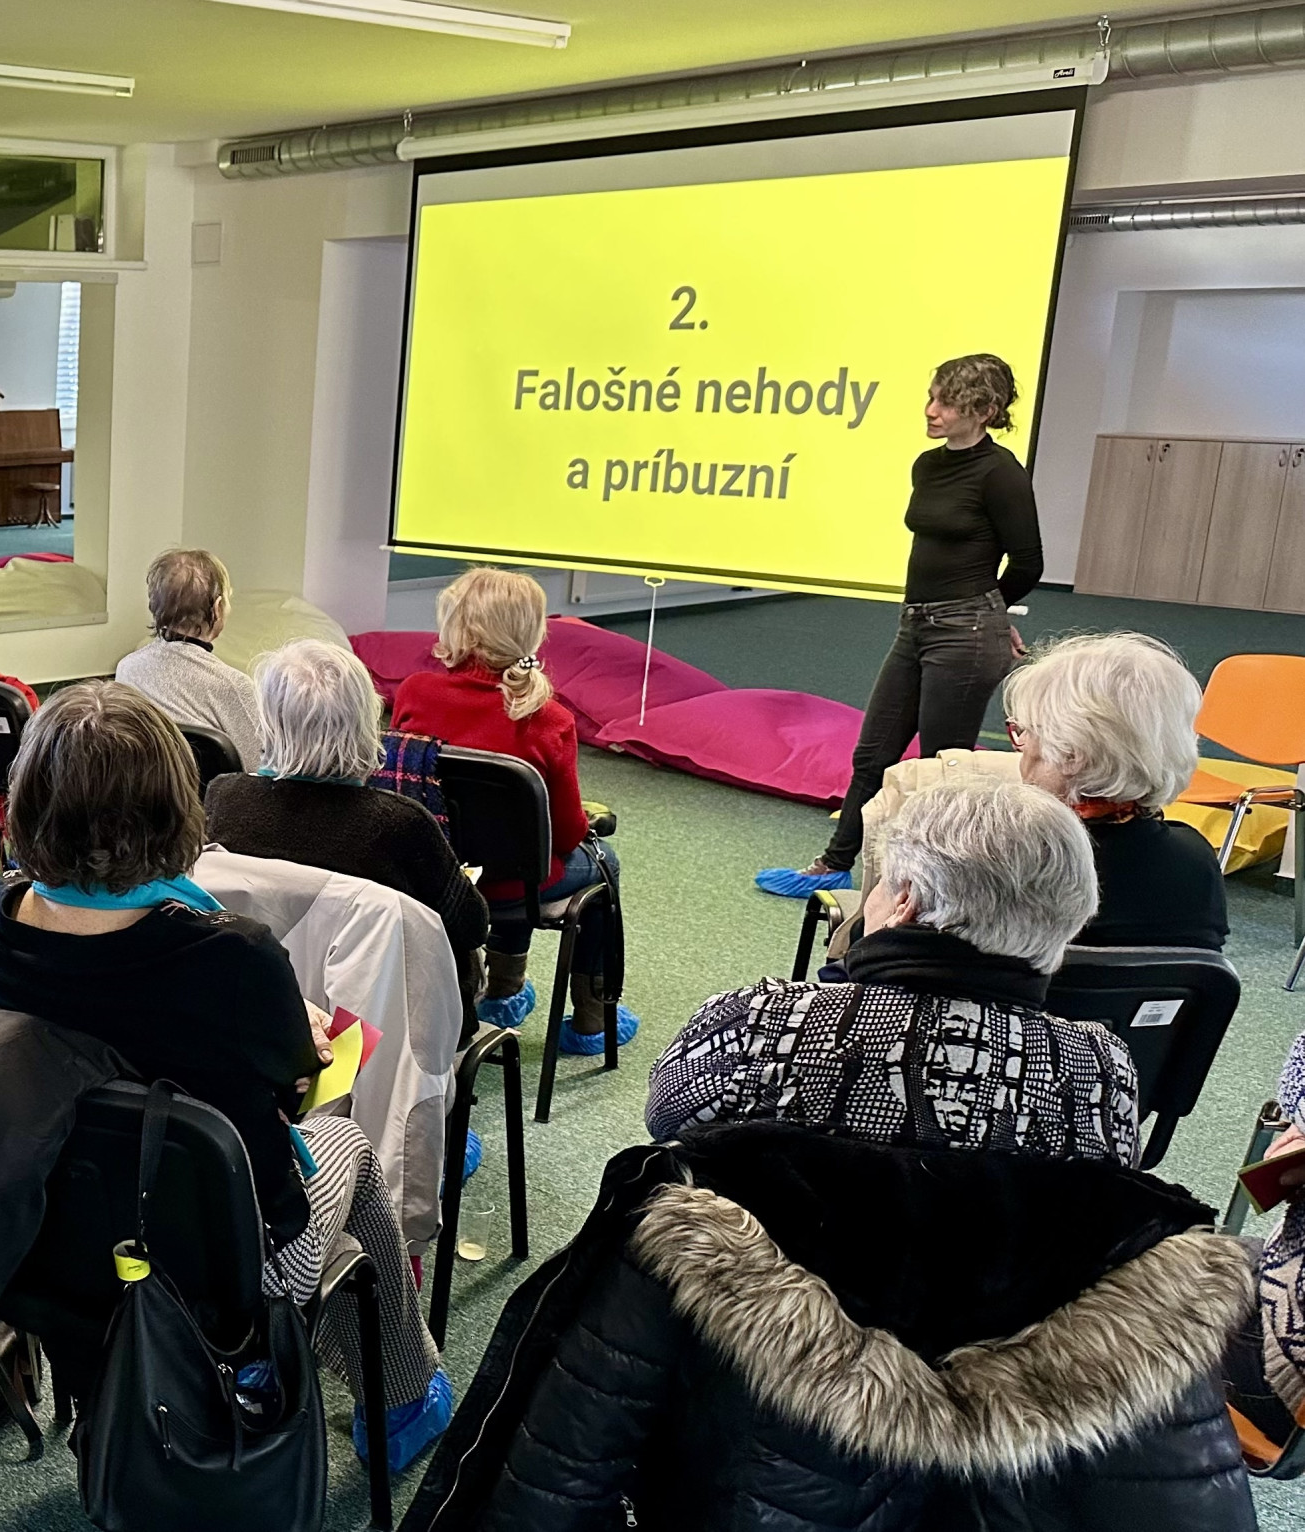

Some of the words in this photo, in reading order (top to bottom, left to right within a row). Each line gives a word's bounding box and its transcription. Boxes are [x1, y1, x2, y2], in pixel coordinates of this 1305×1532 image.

[668, 285, 709, 331] 2.
[514, 366, 681, 412] Falošné
[695, 366, 880, 430] nehody
[566, 457, 590, 490] a
[602, 448, 798, 502] príbuzní
